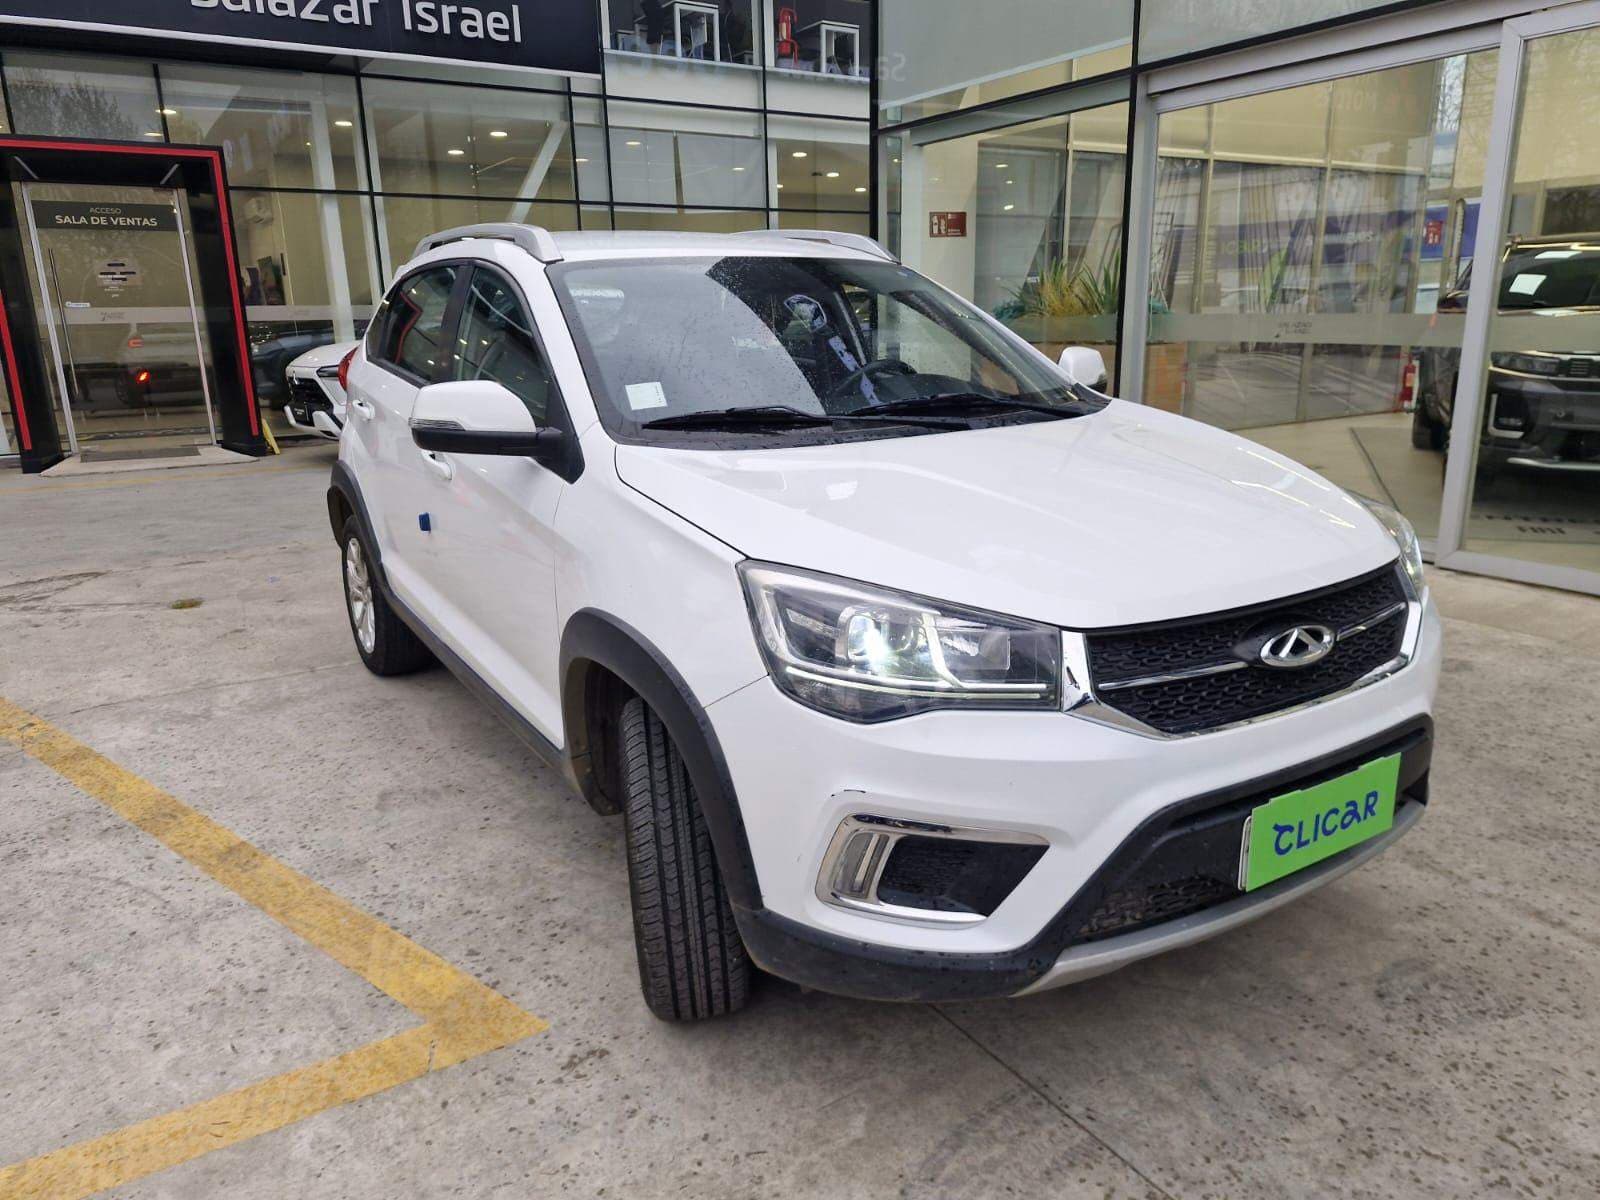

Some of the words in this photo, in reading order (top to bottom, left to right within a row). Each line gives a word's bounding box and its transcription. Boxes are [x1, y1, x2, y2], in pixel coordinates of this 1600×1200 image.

[402, 0, 522, 43] Israel
[55, 214, 89, 225] SALA
[90, 215, 109, 226] DE
[111, 216, 158, 227] VENTAS
